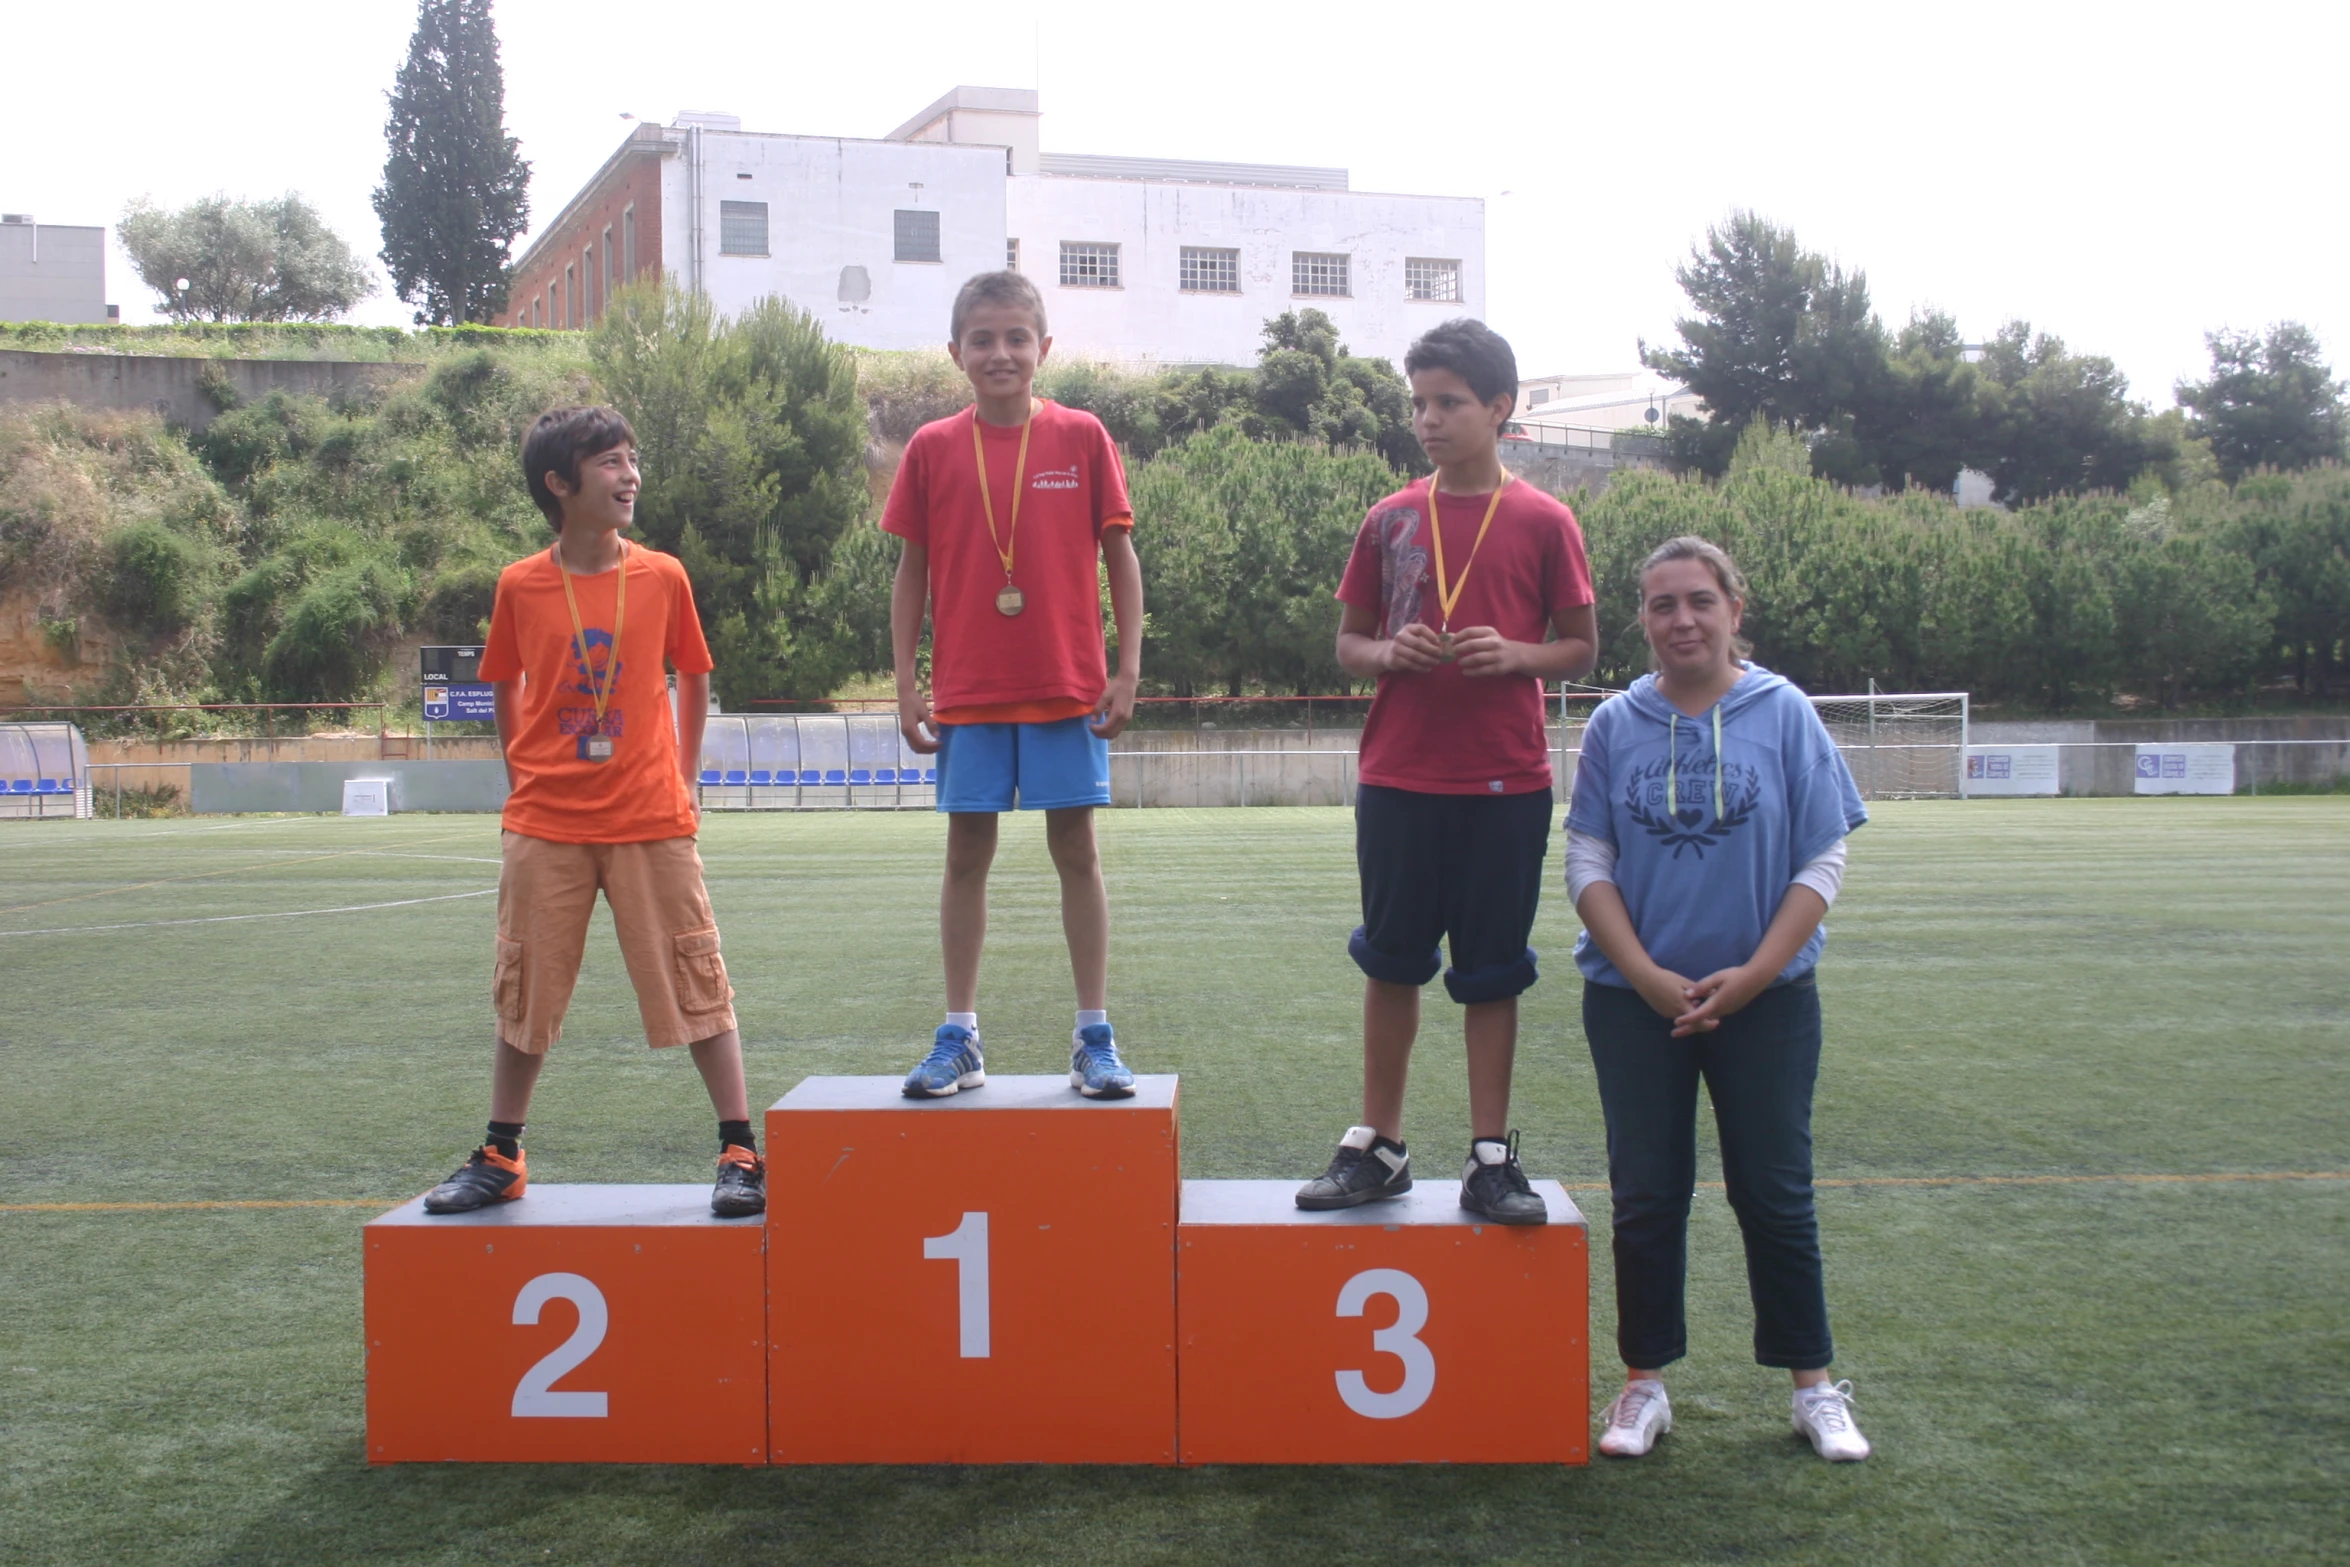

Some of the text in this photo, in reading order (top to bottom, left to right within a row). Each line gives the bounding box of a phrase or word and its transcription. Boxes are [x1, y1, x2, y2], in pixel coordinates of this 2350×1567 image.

[1646, 780, 1739, 806] CREW
[511, 1273, 608, 1417] 2
[923, 1212, 990, 1358] 1
[1335, 1269, 1435, 1419] 3
